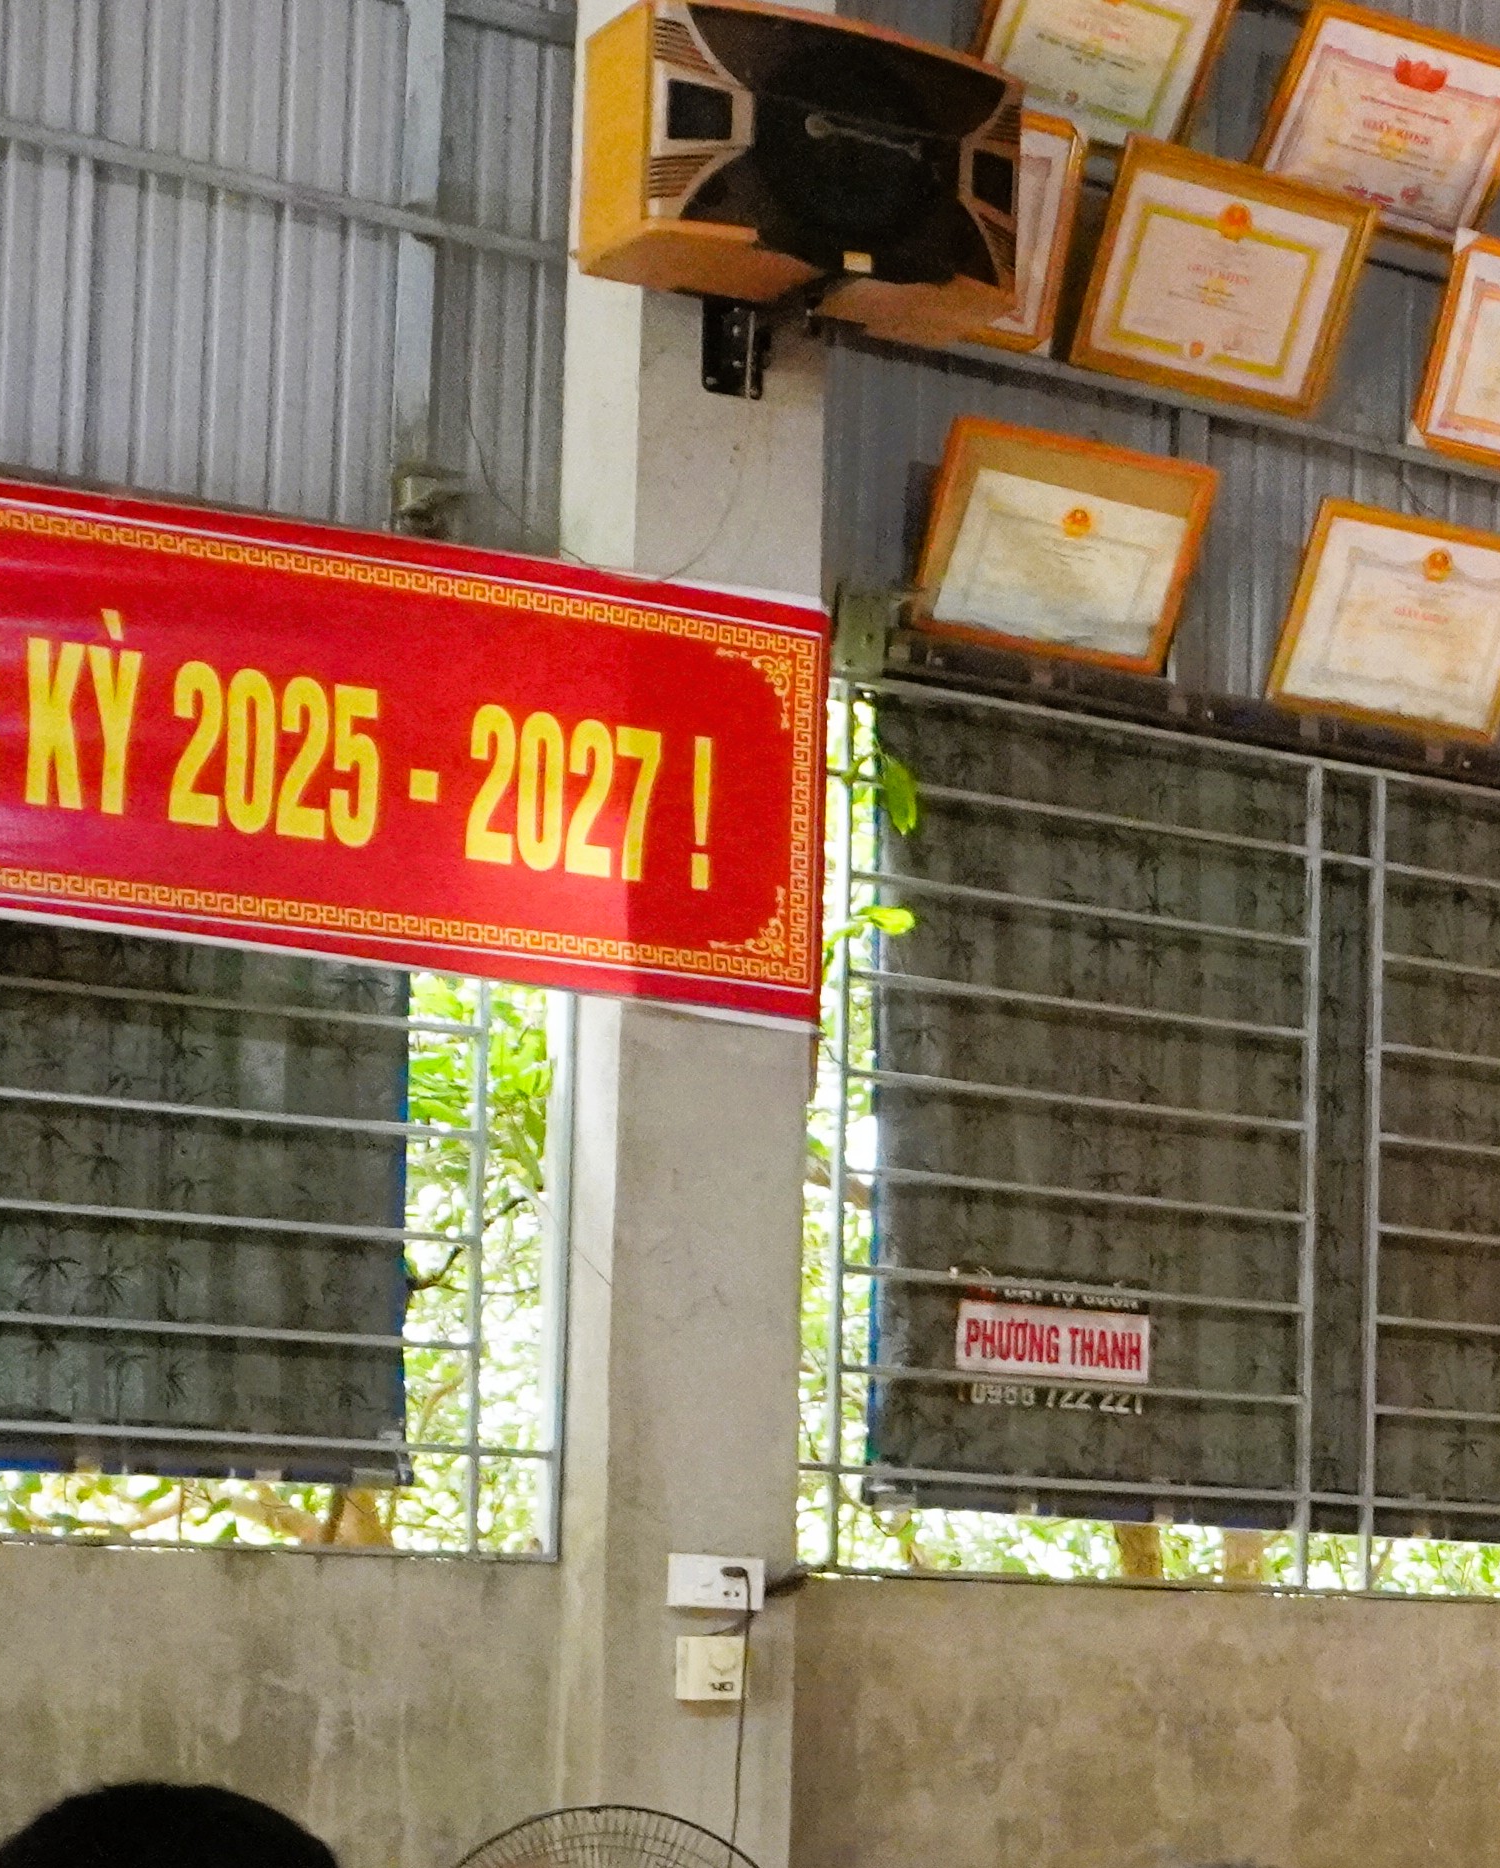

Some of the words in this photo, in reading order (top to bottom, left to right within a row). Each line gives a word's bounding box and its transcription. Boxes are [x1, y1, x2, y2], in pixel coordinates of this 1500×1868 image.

[26, 611, 142, 815] KỲ
[168, 661, 379, 848] 2025
[411, 769, 437, 804] -
[464, 706, 661, 882] 2027
[691, 735, 711, 891] !
[965, 1318, 1060, 1364] PHƯƠNG
[1069, 1327, 1141, 1371] THANH
